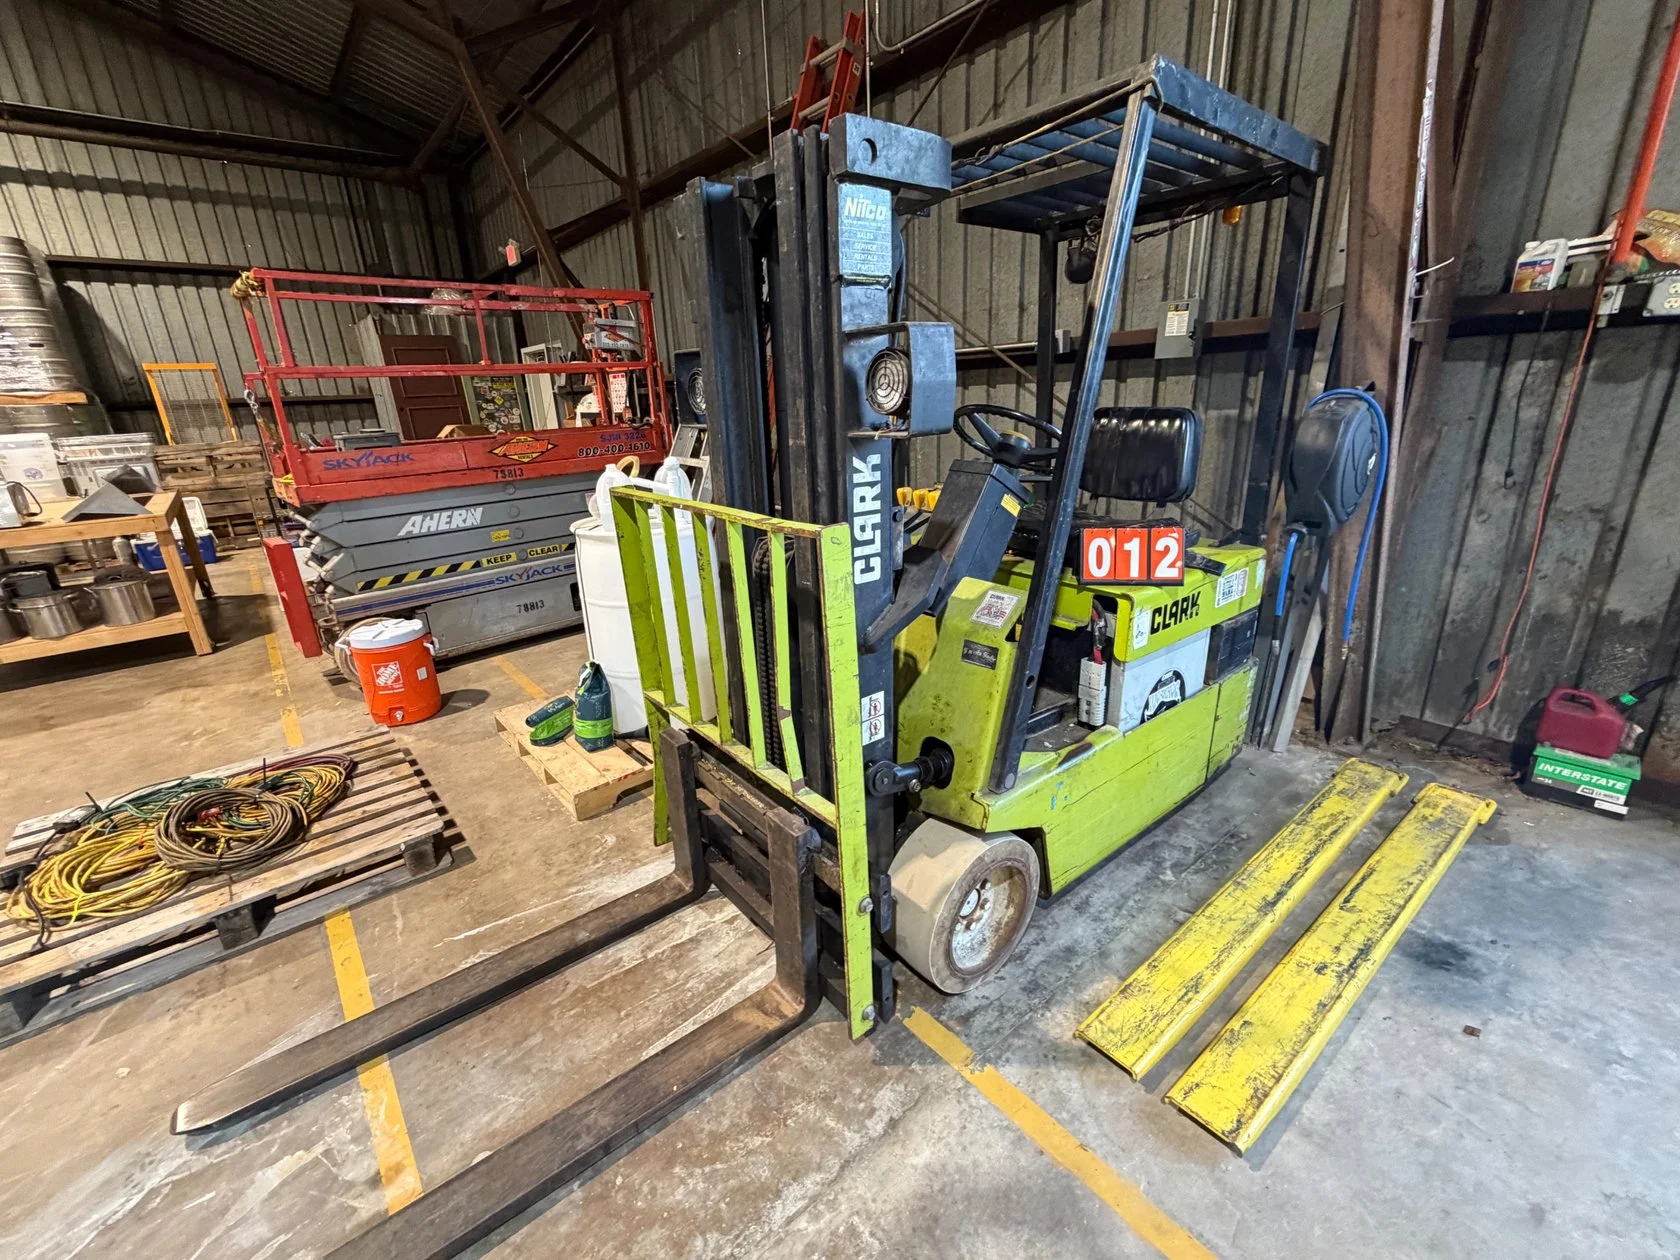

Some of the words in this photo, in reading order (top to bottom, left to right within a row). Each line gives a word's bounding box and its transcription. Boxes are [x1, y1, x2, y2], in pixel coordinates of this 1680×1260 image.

[854, 242, 877, 251] SERVICE
[856, 231, 874, 240] SALES
[322, 449, 414, 471] SKYJACK
[578, 441, 650, 457] 800-400-1610
[397, 507, 484, 537] AHERN
[852, 453, 881, 585] CLARK
[486, 554, 513, 566] KEEP
[528, 545, 559, 558] CLEAR
[1088, 536, 1179, 578] 012
[495, 563, 563, 585] SKYJACK
[516, 599, 545, 614] 78813
[1150, 590, 1202, 636] CLARK
[1538, 762, 1628, 790] INTERSTATE
